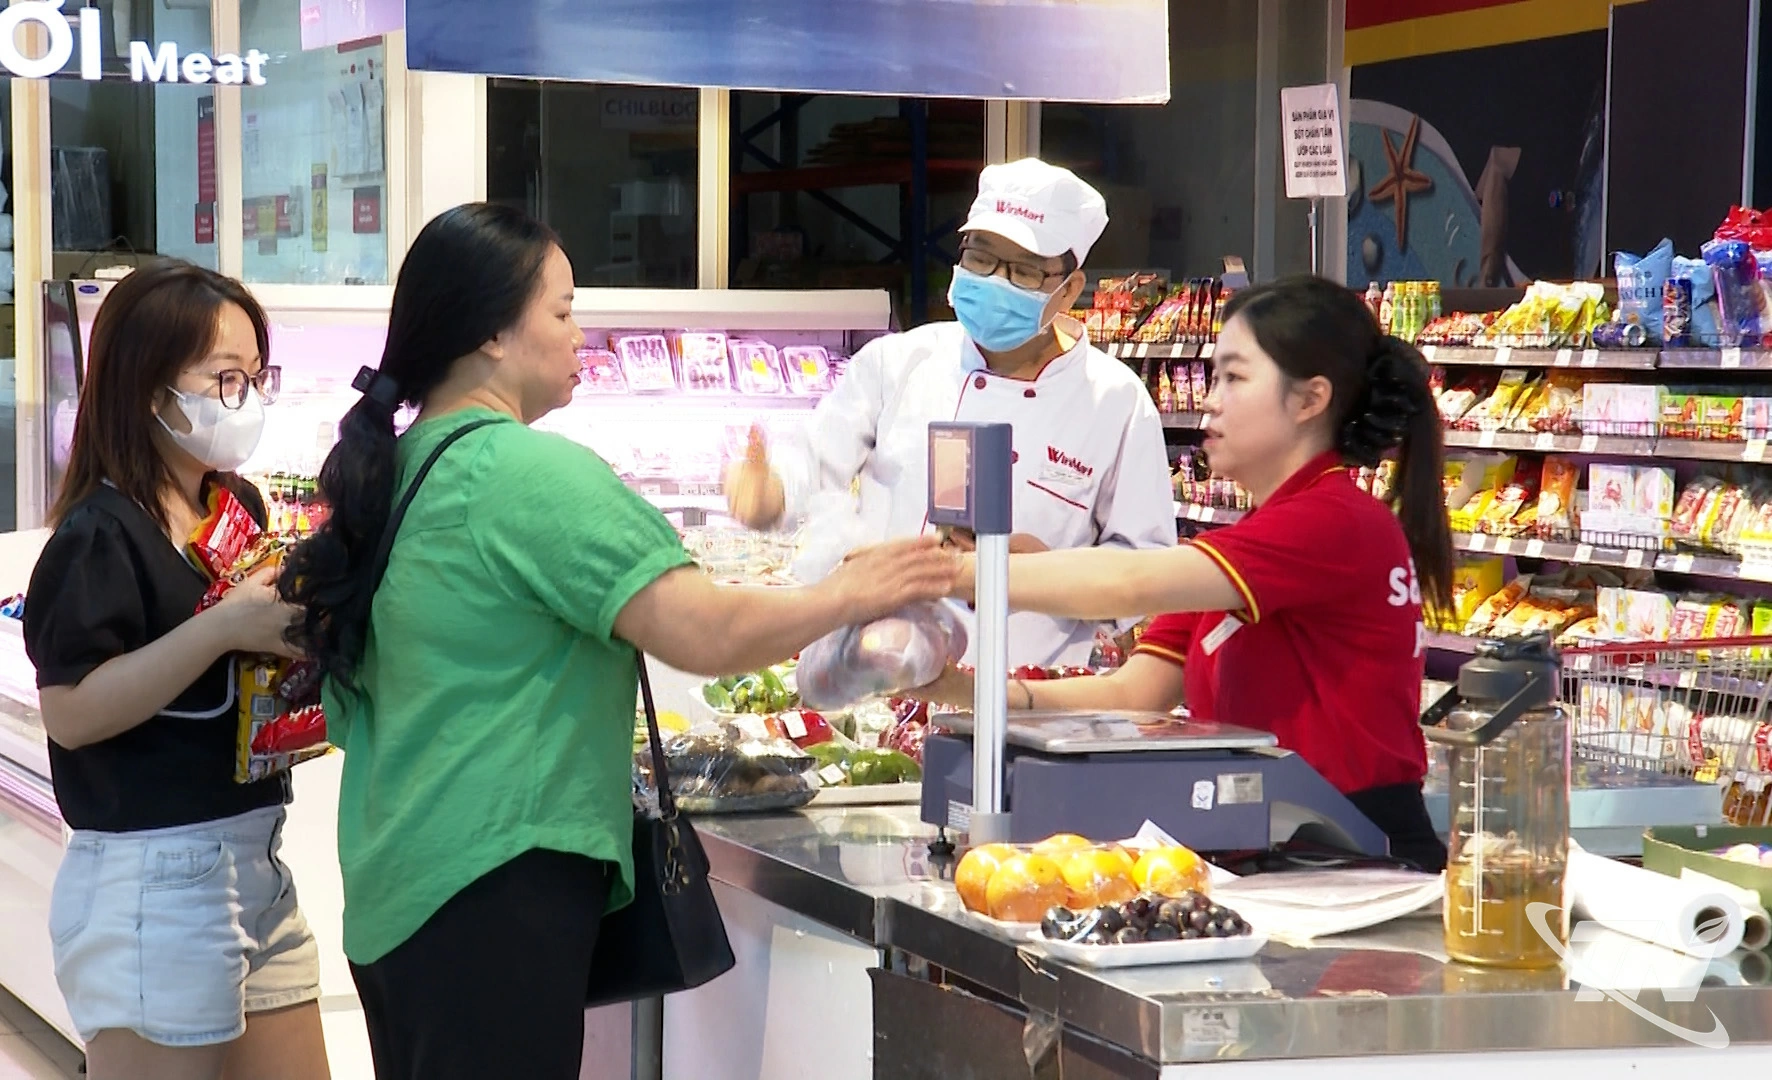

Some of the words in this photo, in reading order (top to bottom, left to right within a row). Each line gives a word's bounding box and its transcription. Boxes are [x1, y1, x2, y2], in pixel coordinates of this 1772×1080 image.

[130, 41, 267, 85] Meat
[996, 199, 1045, 224] WinMart
[1047, 445, 1093, 477] WinMart
